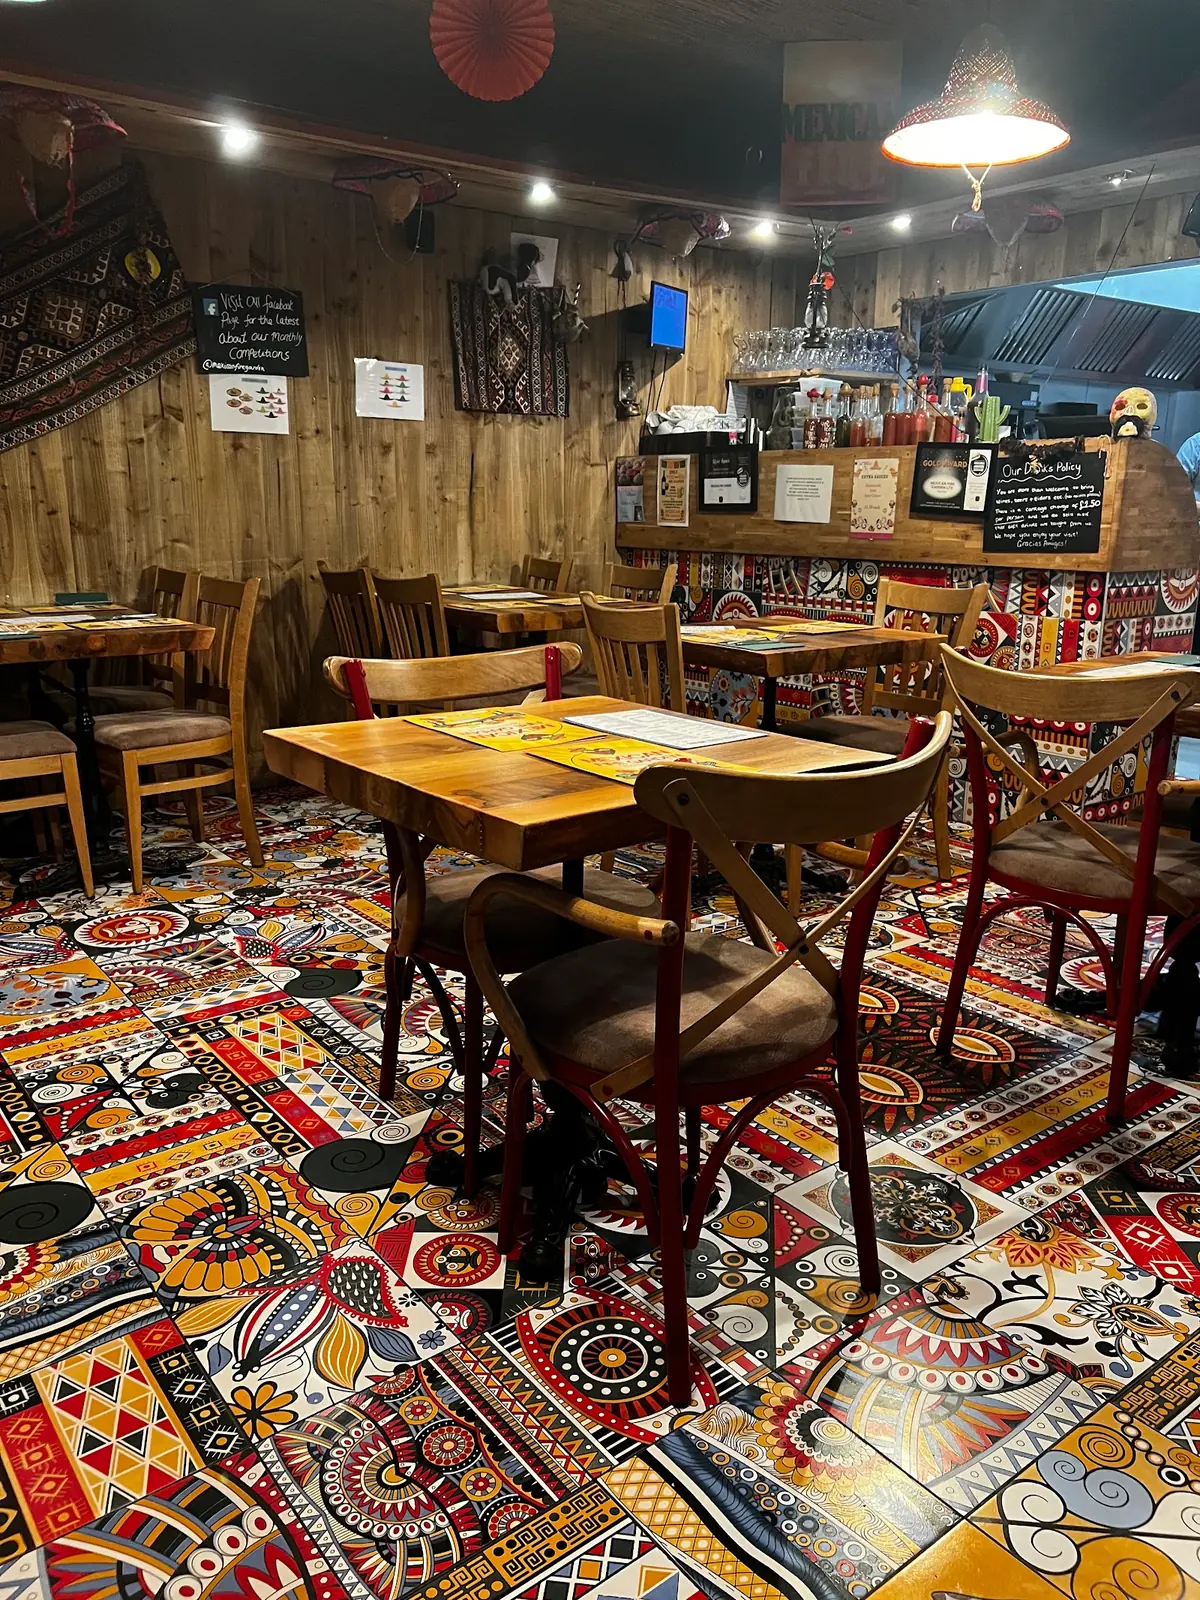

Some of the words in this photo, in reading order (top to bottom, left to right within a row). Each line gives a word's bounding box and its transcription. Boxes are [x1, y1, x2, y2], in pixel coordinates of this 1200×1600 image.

[220, 292, 244, 312] Visit
[221, 311, 240, 331] Page
[243, 314, 258, 328] for
[258, 314, 273, 326] the
[923, 459, 941, 467] GOLD
[1002, 464, 1022, 477] Our
[1056, 461, 1081, 476] Policy
[1080, 483, 1095, 493] bring
[994, 532, 1002, 540] We
[1019, 533, 1031, 541] you
[1032, 532, 1048, 540] enjoy
[1048, 532, 1062, 541] your
[1016, 540, 1042, 548] Gracias
